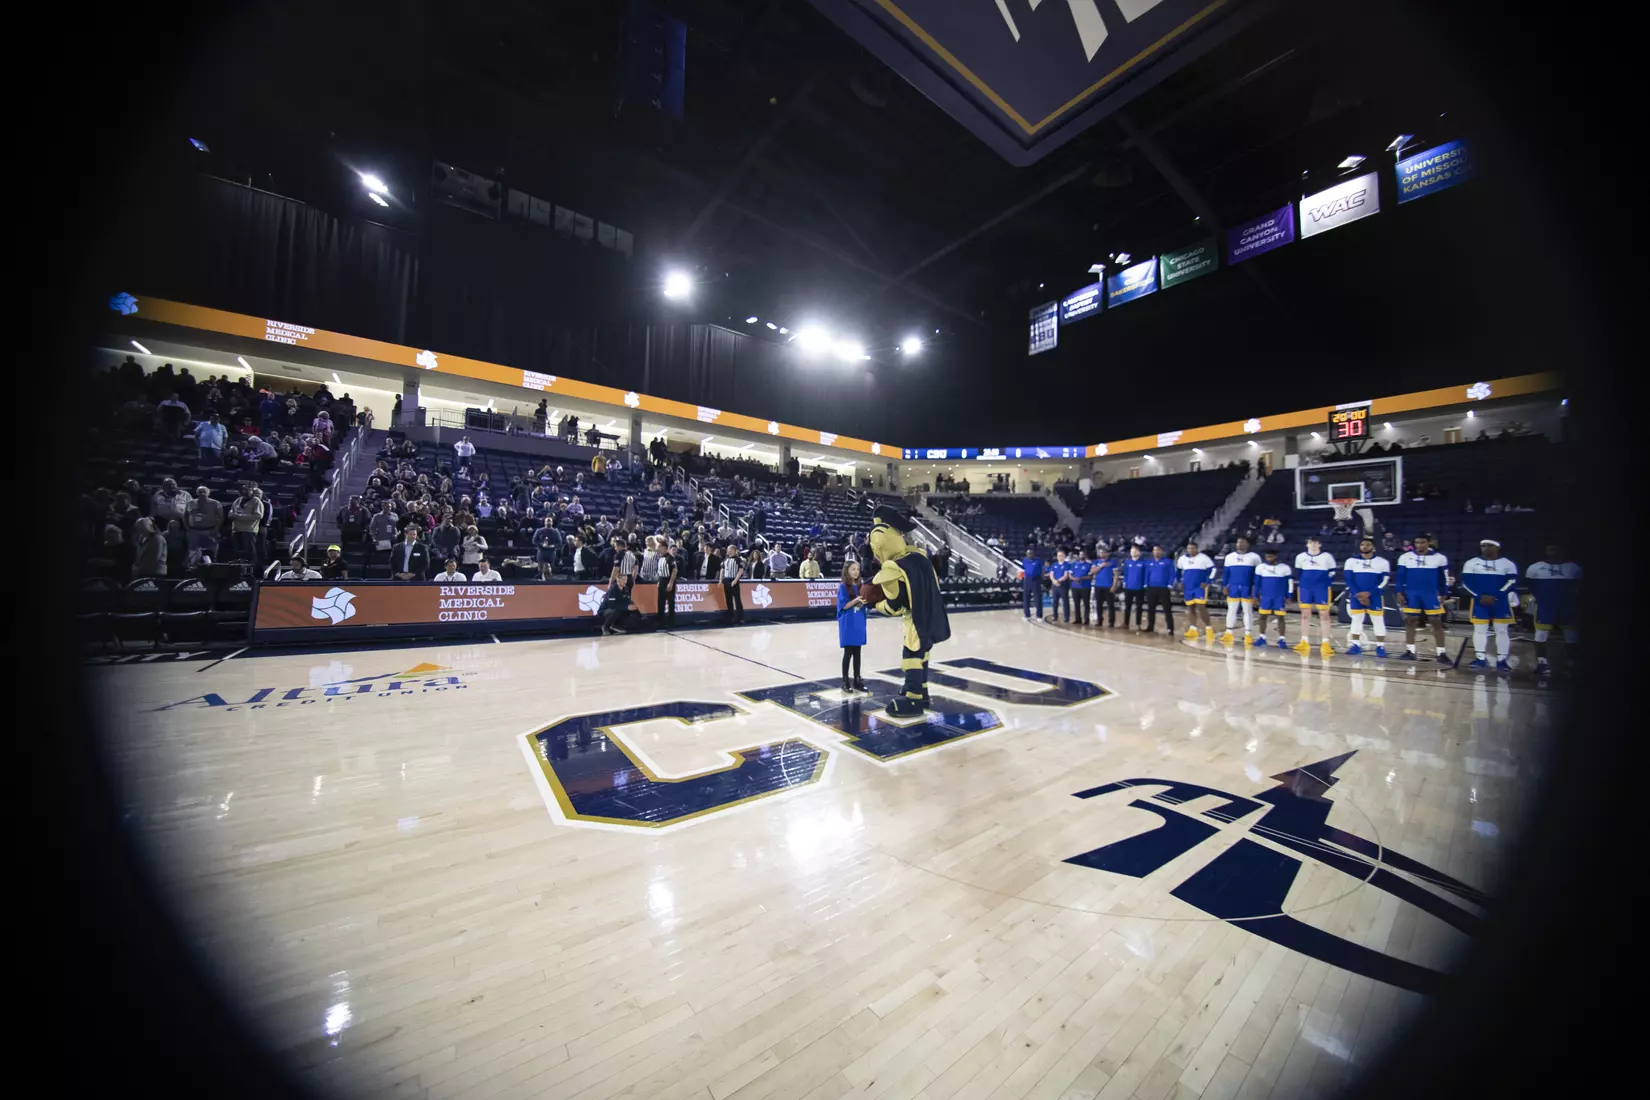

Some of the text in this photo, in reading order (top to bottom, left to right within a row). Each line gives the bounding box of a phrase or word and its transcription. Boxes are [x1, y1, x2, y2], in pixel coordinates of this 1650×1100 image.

[1402, 174, 1419, 184] OF
[1403, 171, 1453, 193] KANSAS
[1308, 189, 1367, 222] WAC
[1239, 228, 1278, 245] CANYON
[1242, 219, 1276, 237] GRAND
[1233, 231, 1286, 256] UNIVERSITY
[1169, 247, 1205, 265] CHICAGO
[1176, 256, 1200, 270] STATE
[1166, 259, 1212, 281] UNIVERSITY
[266, 319, 315, 335] RIVERSIDE
[266, 327, 308, 341] MEDICAL
[265, 334, 297, 346] CLINIC
[1338, 419, 1363, 438] 30
[440, 585, 515, 596] RIVERSIDE
[676, 583, 710, 592] ERSIDE
[439, 597, 505, 609] MEDICAL
[675, 593, 704, 602] DICAL
[439, 610, 488, 622] CLINIC
[139, 676, 467, 714] Altura
[226, 684, 468, 712] CREDIT UNION
[518, 663, 1119, 835] CBU
